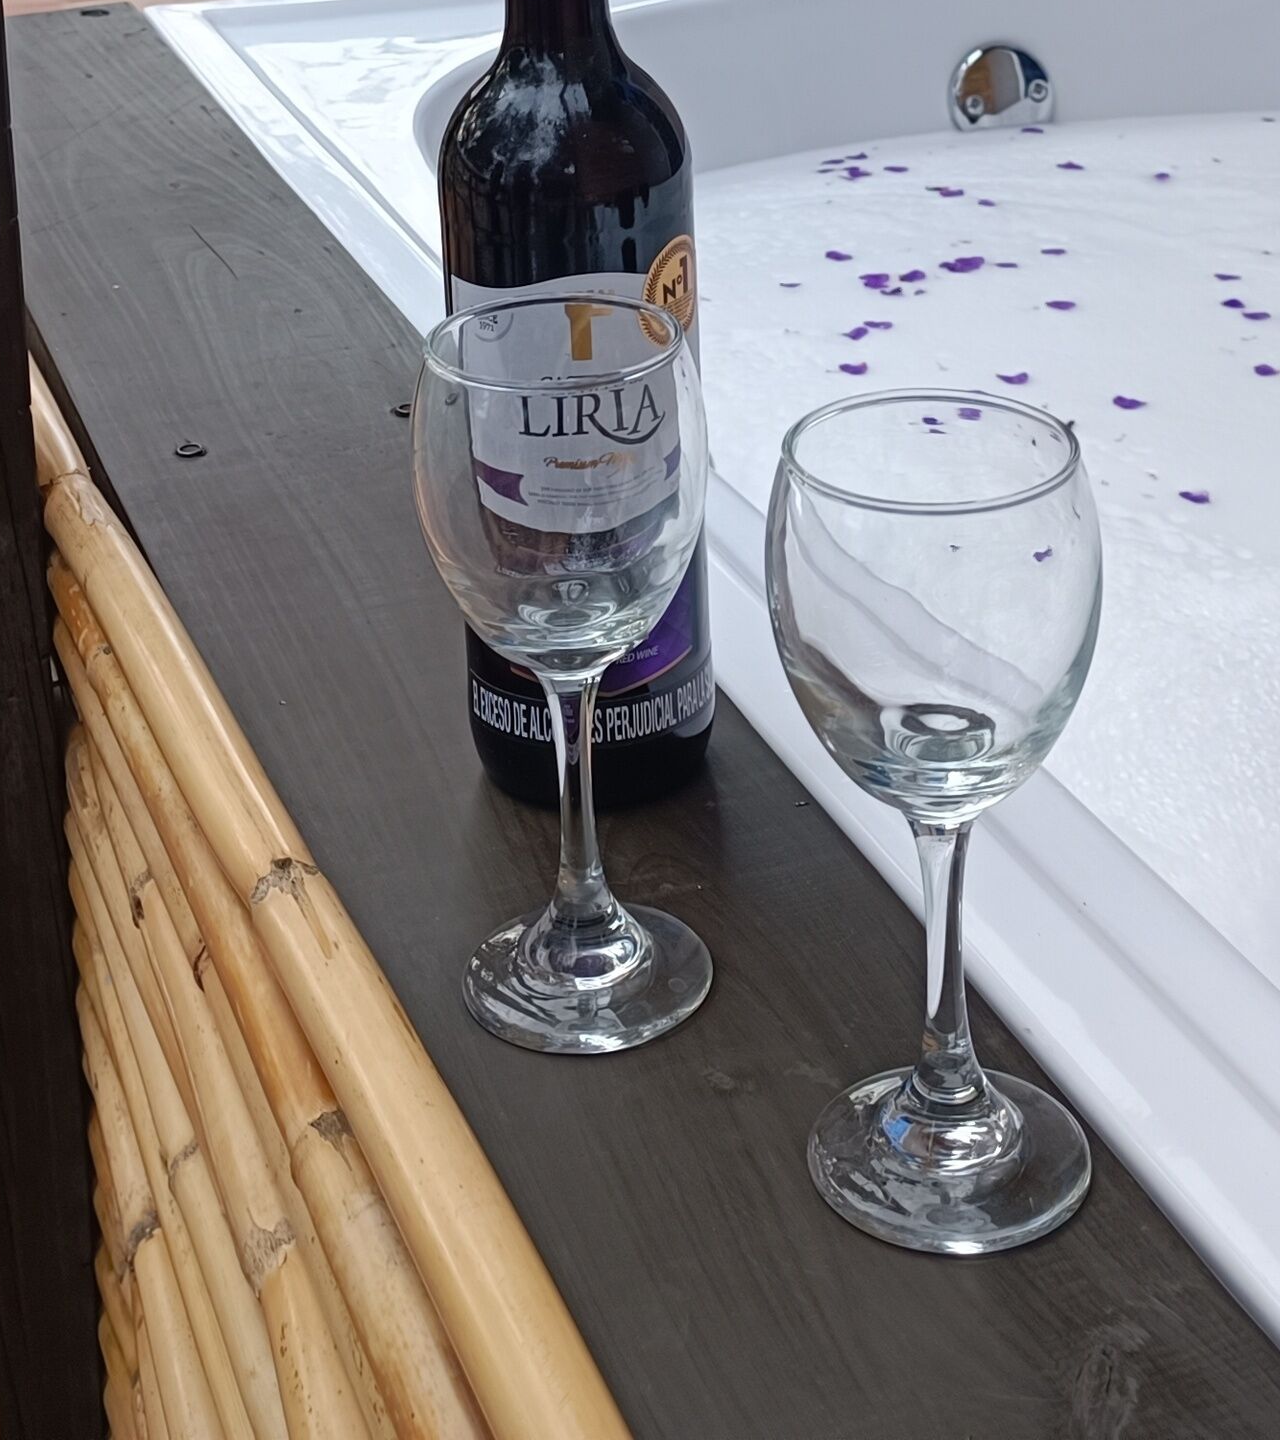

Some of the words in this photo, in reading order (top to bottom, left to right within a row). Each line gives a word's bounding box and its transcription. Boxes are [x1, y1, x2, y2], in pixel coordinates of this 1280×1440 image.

[517, 384, 666, 444] LIRIA
[636, 645, 659, 661] WINE
[480, 686, 512, 733] EXCESO
[513, 701, 528, 738] DE
[606, 691, 677, 743] PERJUDICIAL
[677, 677, 699, 723] PARA
